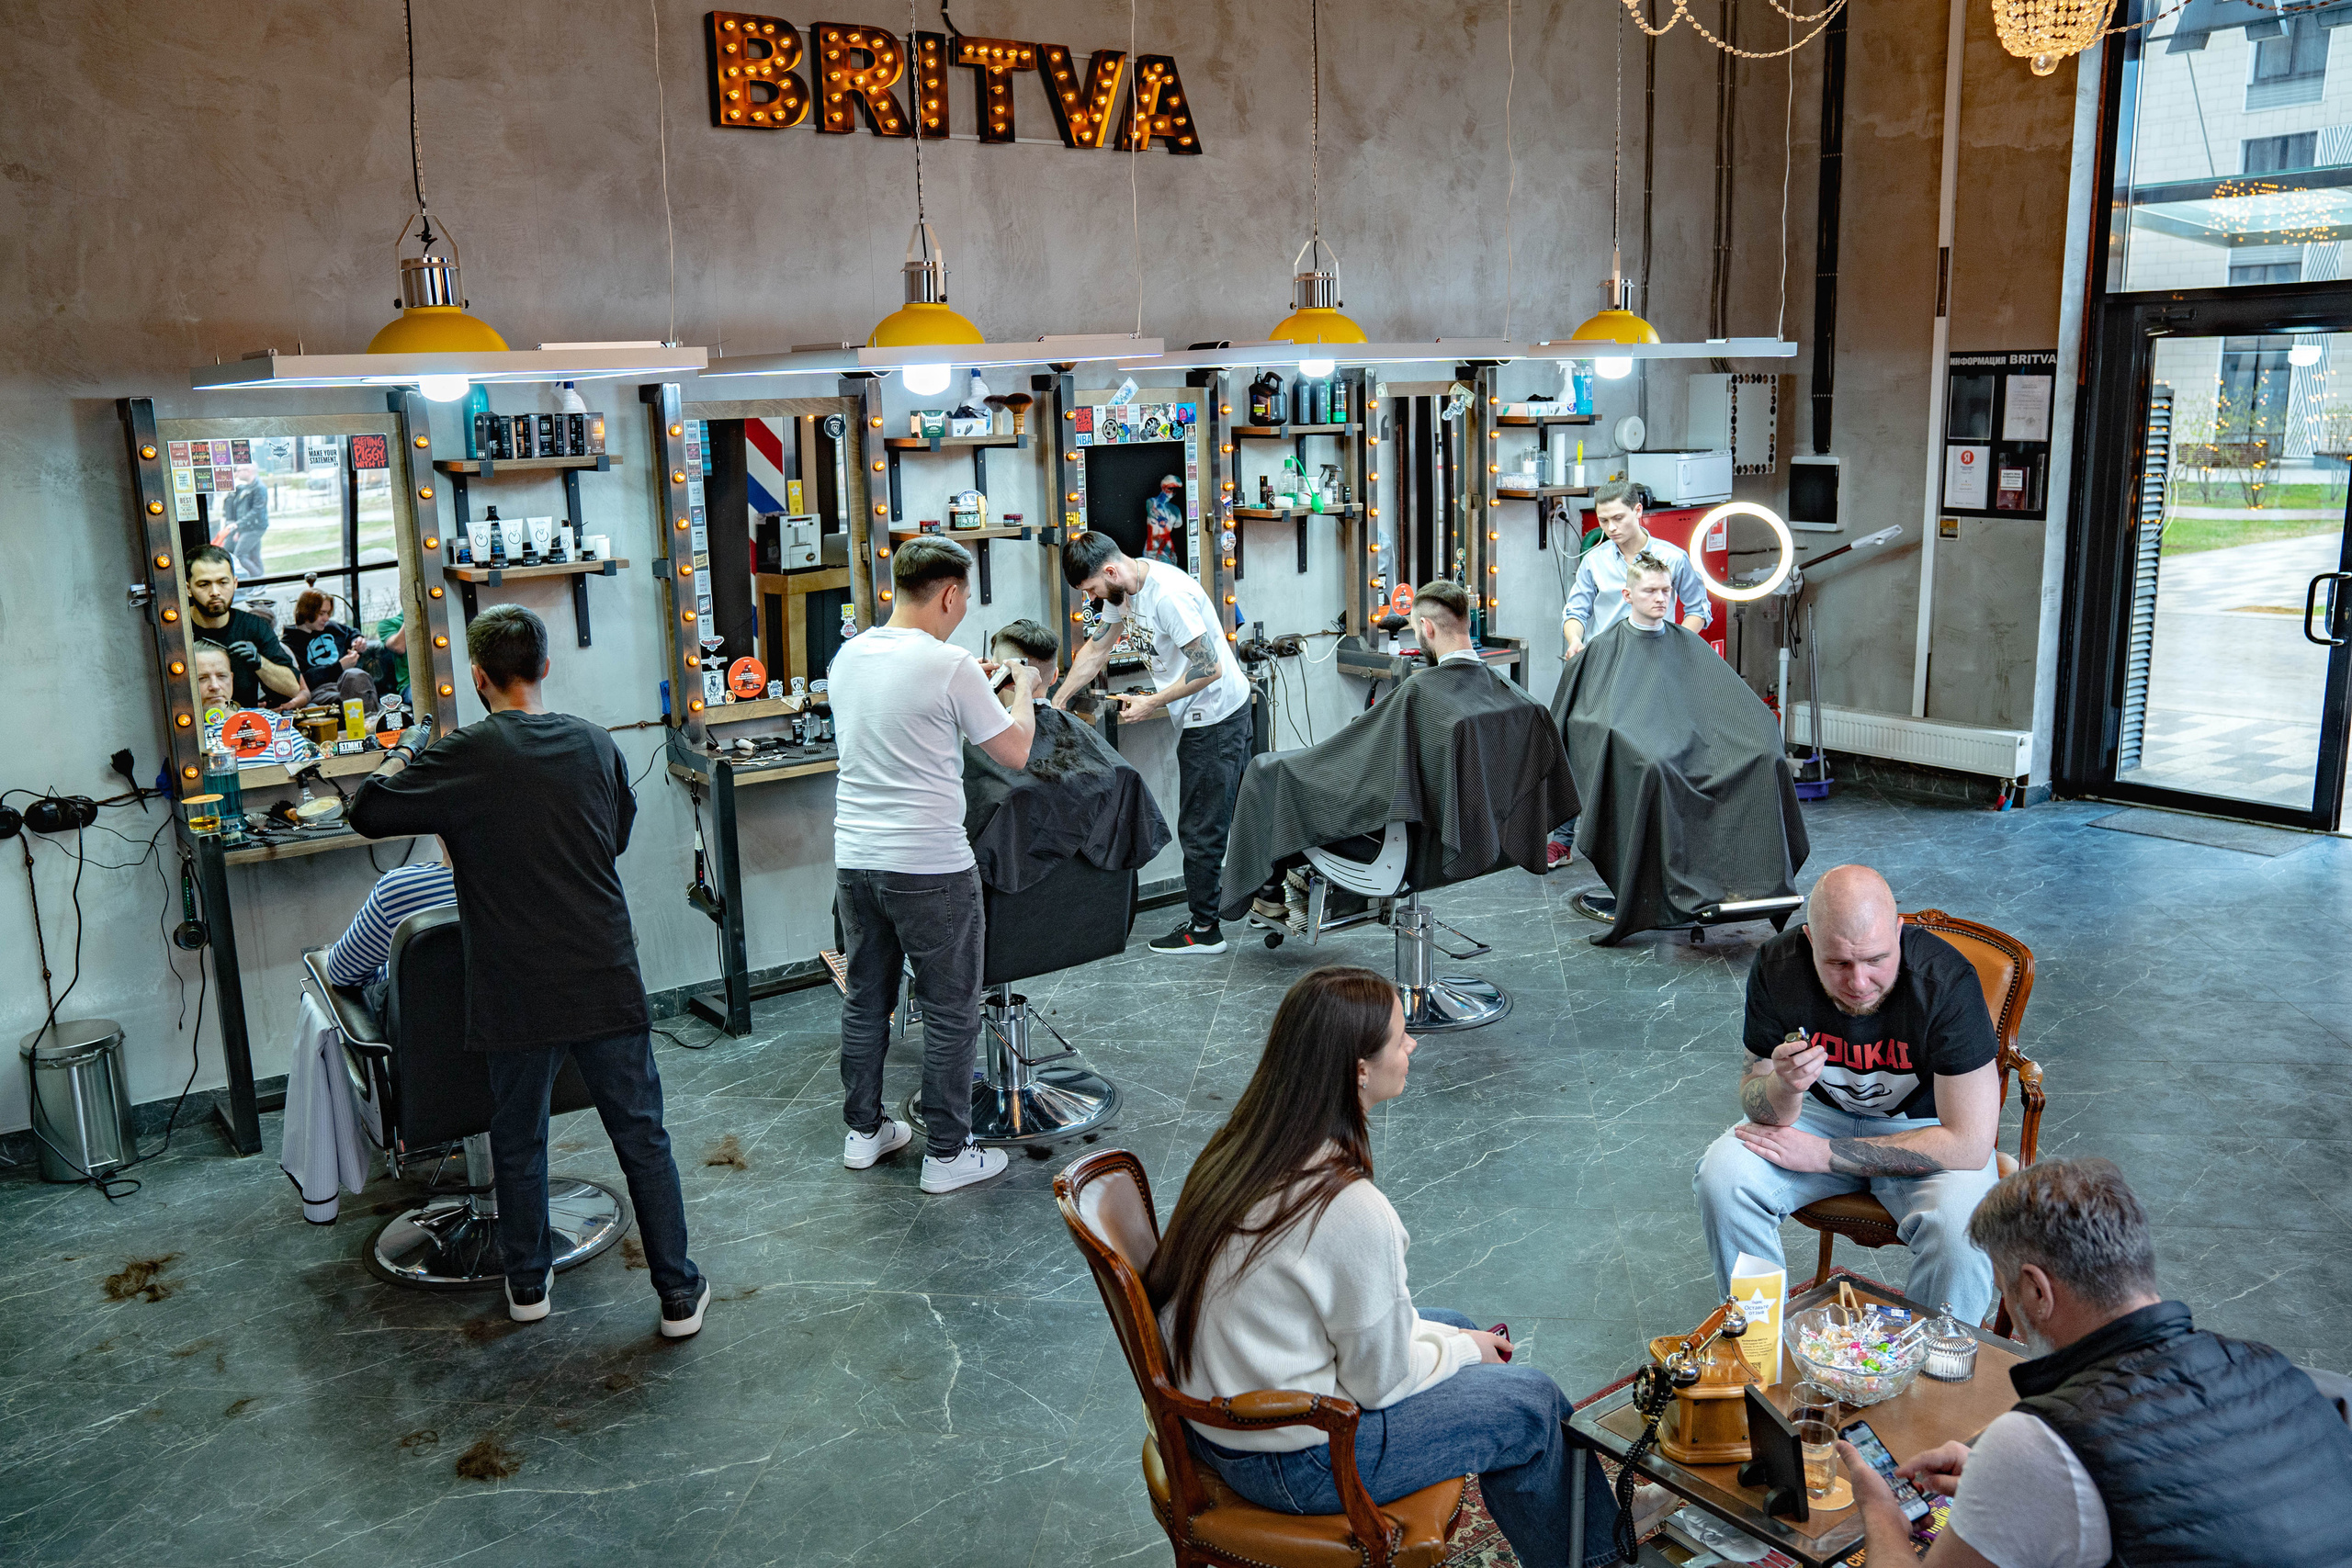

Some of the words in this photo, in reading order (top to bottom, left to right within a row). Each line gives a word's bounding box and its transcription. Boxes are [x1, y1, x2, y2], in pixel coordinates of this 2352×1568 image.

[707, 11, 1203, 154] BRITVA
[1950, 356, 2007, 367] ИНФОРМАЦИЯ
[2009, 354, 2057, 365] BRITVA
[1076, 434, 1092, 445] NBA
[1963, 452, 1971, 462] Я
[356, 459, 376, 468] WITH
[378, 459, 386, 468] IT
[339, 740, 364, 750] STMNT
